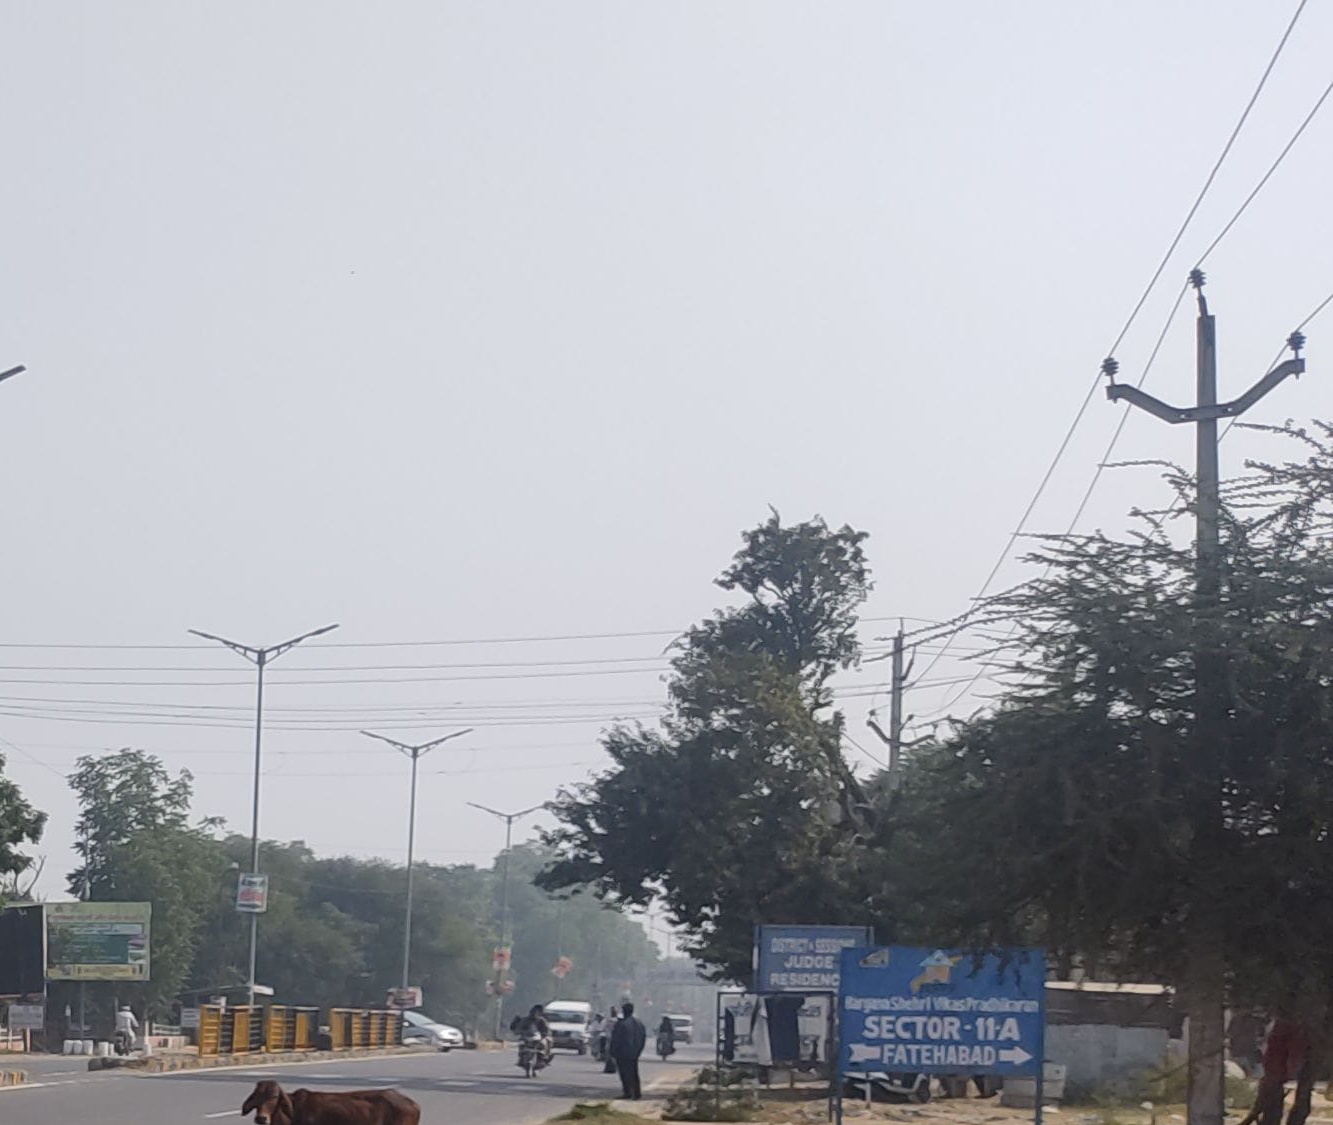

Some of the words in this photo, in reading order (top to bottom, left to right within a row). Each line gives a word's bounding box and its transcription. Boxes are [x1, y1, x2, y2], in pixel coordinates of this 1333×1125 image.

[783, 955, 834, 969] JUDGE
[862, 1015, 961, 1041] SECTOR
[882, 1043, 996, 1066] FATEHABAD
